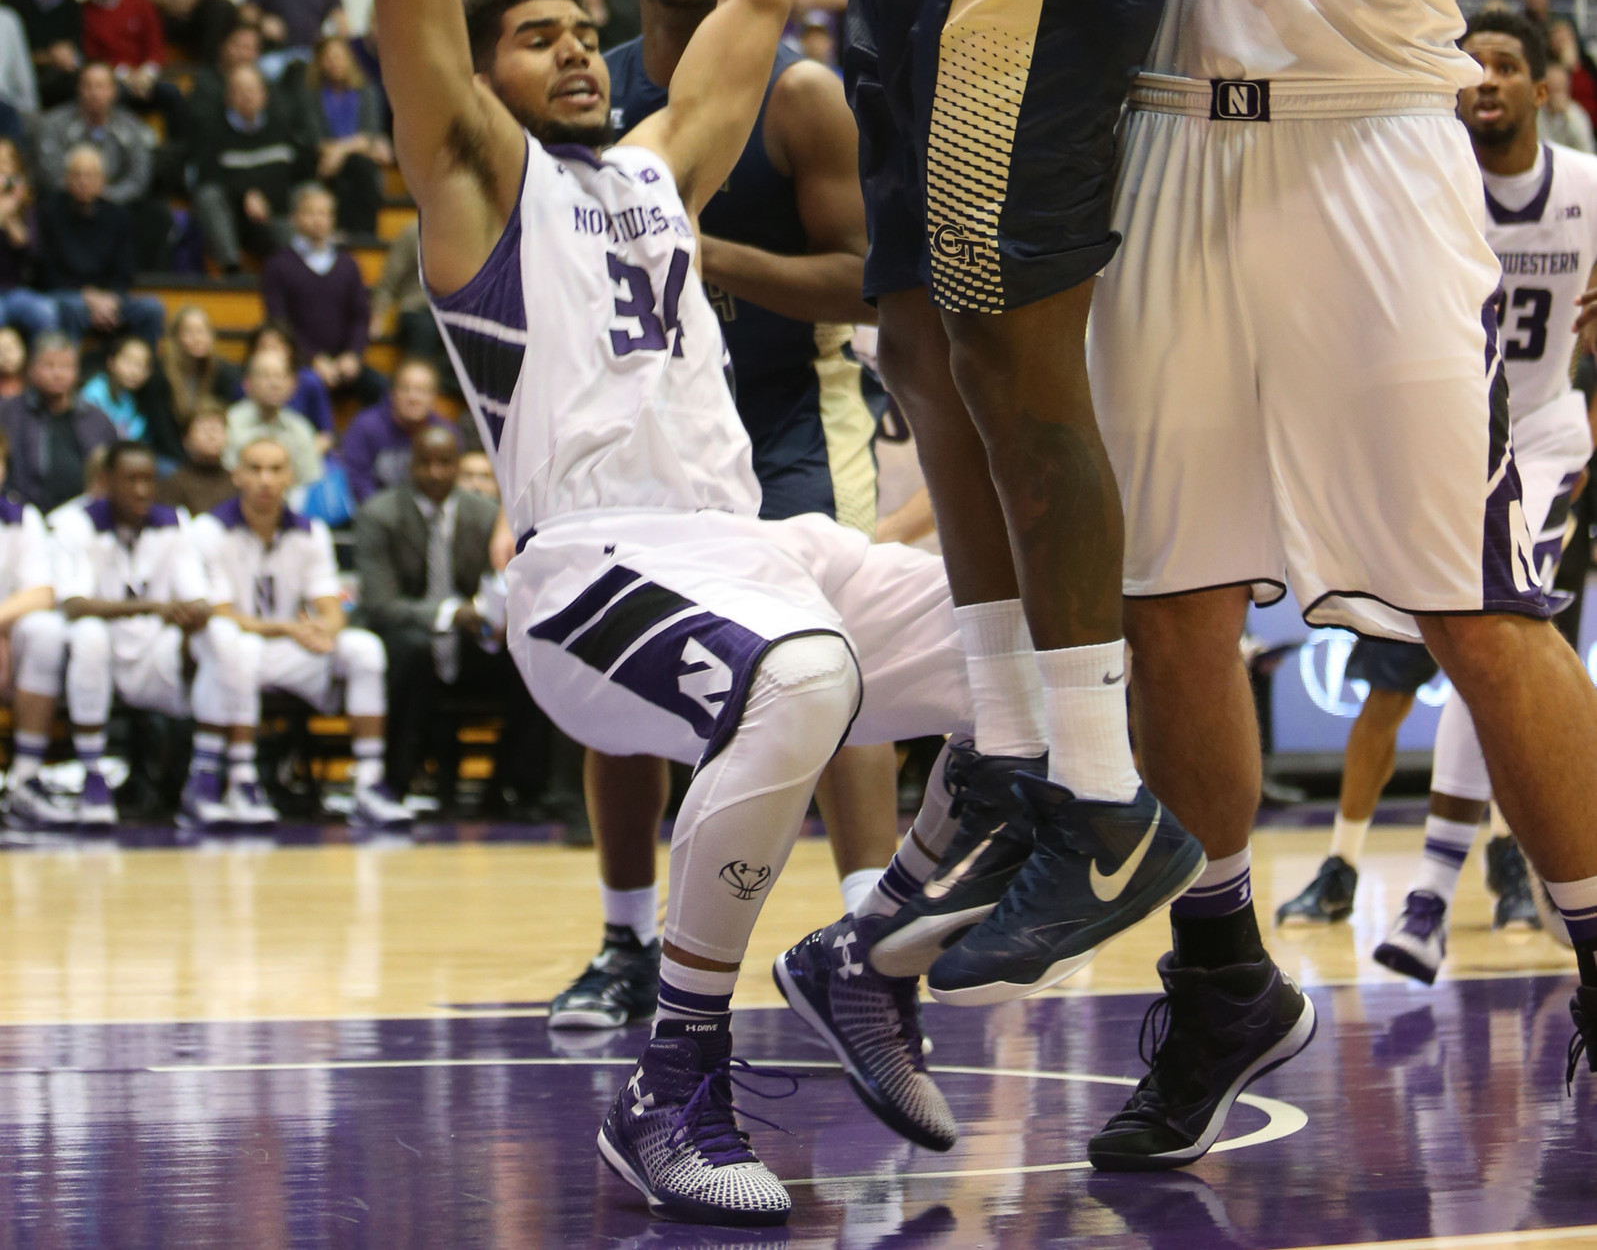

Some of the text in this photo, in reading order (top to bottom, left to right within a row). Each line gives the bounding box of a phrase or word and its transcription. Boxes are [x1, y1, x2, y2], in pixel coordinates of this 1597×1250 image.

[1228, 85, 1249, 115] N
[1499, 251, 1580, 275] WESTERN
[696, 1023, 719, 1032] DRIVE
